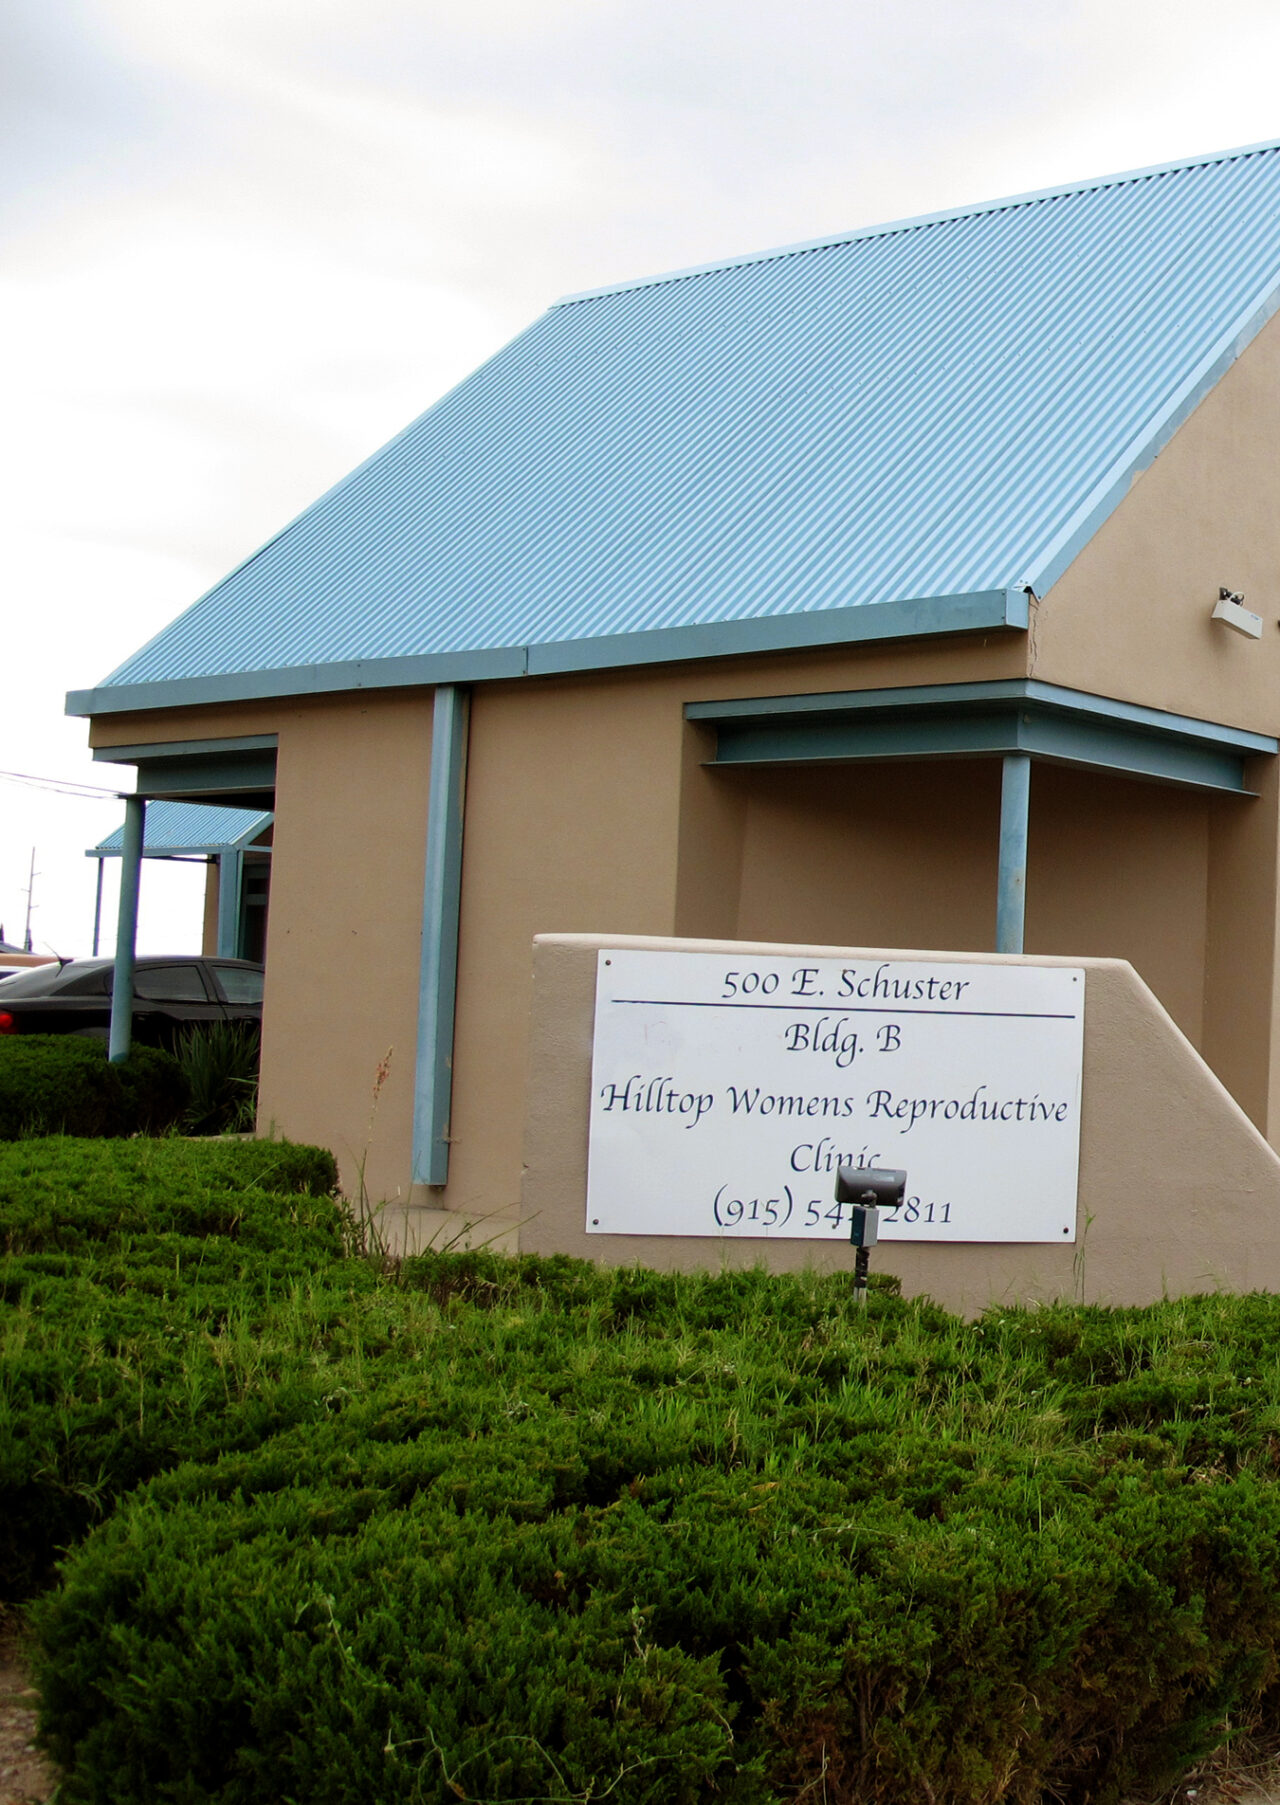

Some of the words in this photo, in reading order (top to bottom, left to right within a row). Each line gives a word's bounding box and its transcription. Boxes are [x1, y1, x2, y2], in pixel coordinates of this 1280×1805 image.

[721, 971, 780, 999] 500
[791, 968, 824, 997] E.
[837, 963, 970, 1001] Schuster
[784, 1016, 865, 1068] Bldg.
[876, 1022, 903, 1052] B
[600, 1074, 714, 1130] Hilltop
[726, 1086, 854, 1117] Womens
[866, 1085, 1068, 1134] Reproductive
[713, 1184, 793, 1228] (915)
